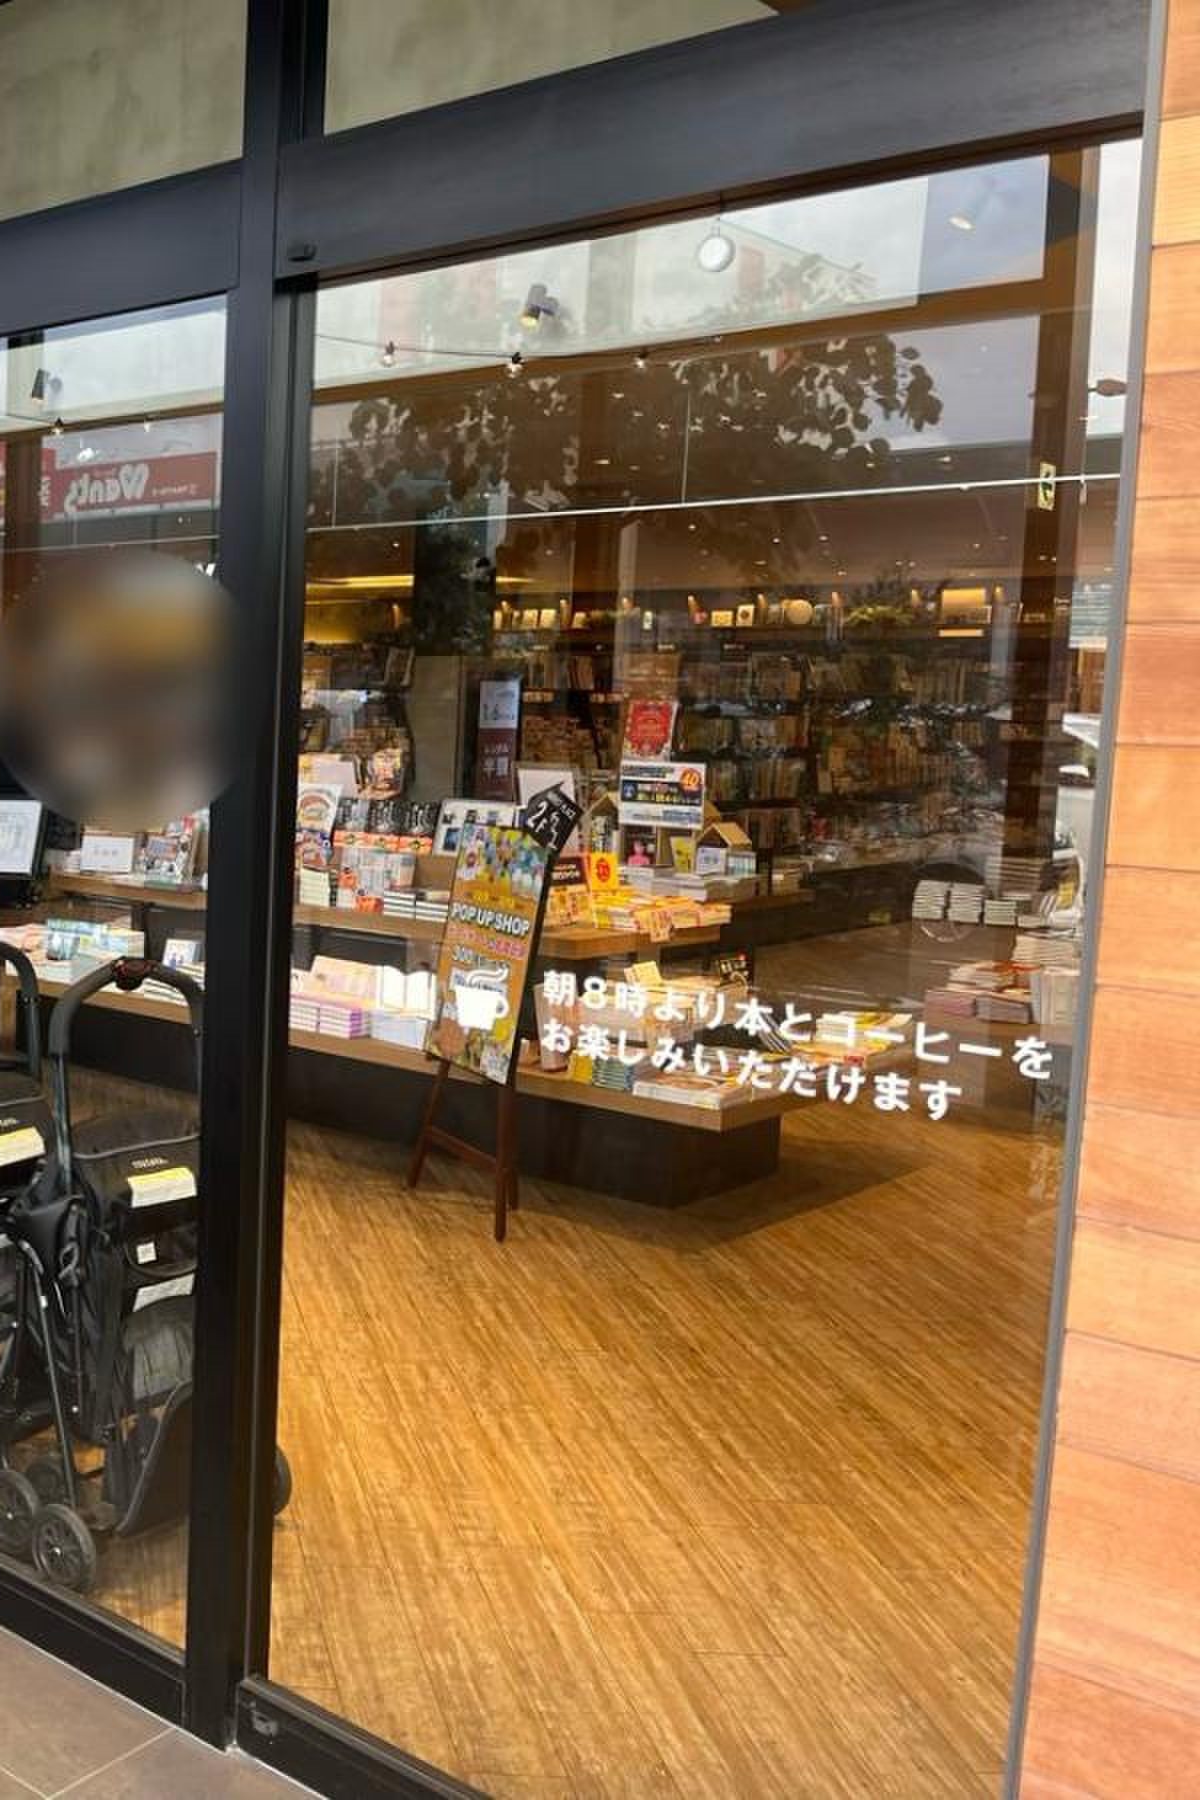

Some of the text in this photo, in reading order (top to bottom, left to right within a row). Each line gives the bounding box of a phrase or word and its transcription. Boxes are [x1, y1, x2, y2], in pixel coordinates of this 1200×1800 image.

[452, 903, 530, 936] POP UP SHOP
[540, 1022, 963, 1121] お楽しみいただけます
[543, 970, 1054, 1081] 朝8時より本とコーヒーを
